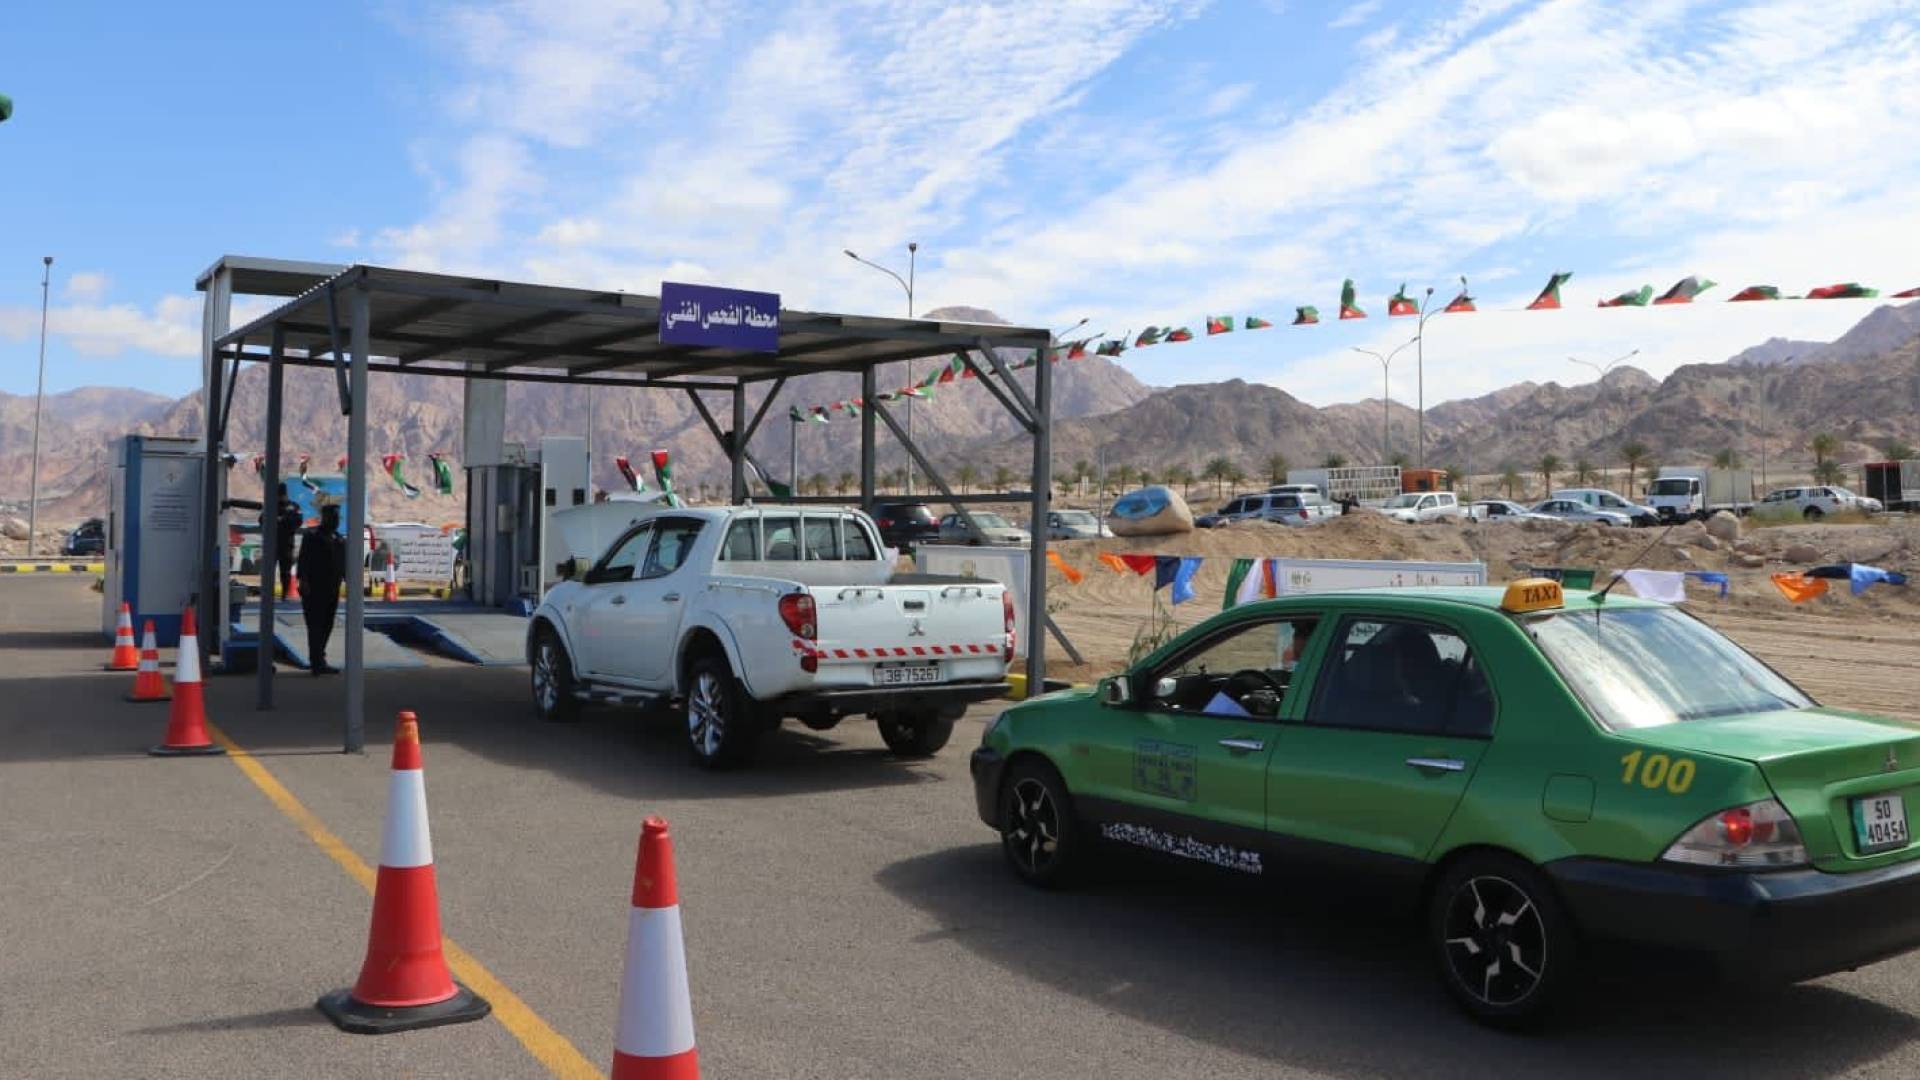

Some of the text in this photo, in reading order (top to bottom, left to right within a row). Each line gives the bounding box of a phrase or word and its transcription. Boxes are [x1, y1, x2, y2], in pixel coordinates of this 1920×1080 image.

[666, 300, 778, 330] محطة الفحص الفني
[1521, 583, 1557, 603] TAXI
[1620, 749, 1696, 794] 100
[1867, 820, 1906, 844] 40454
